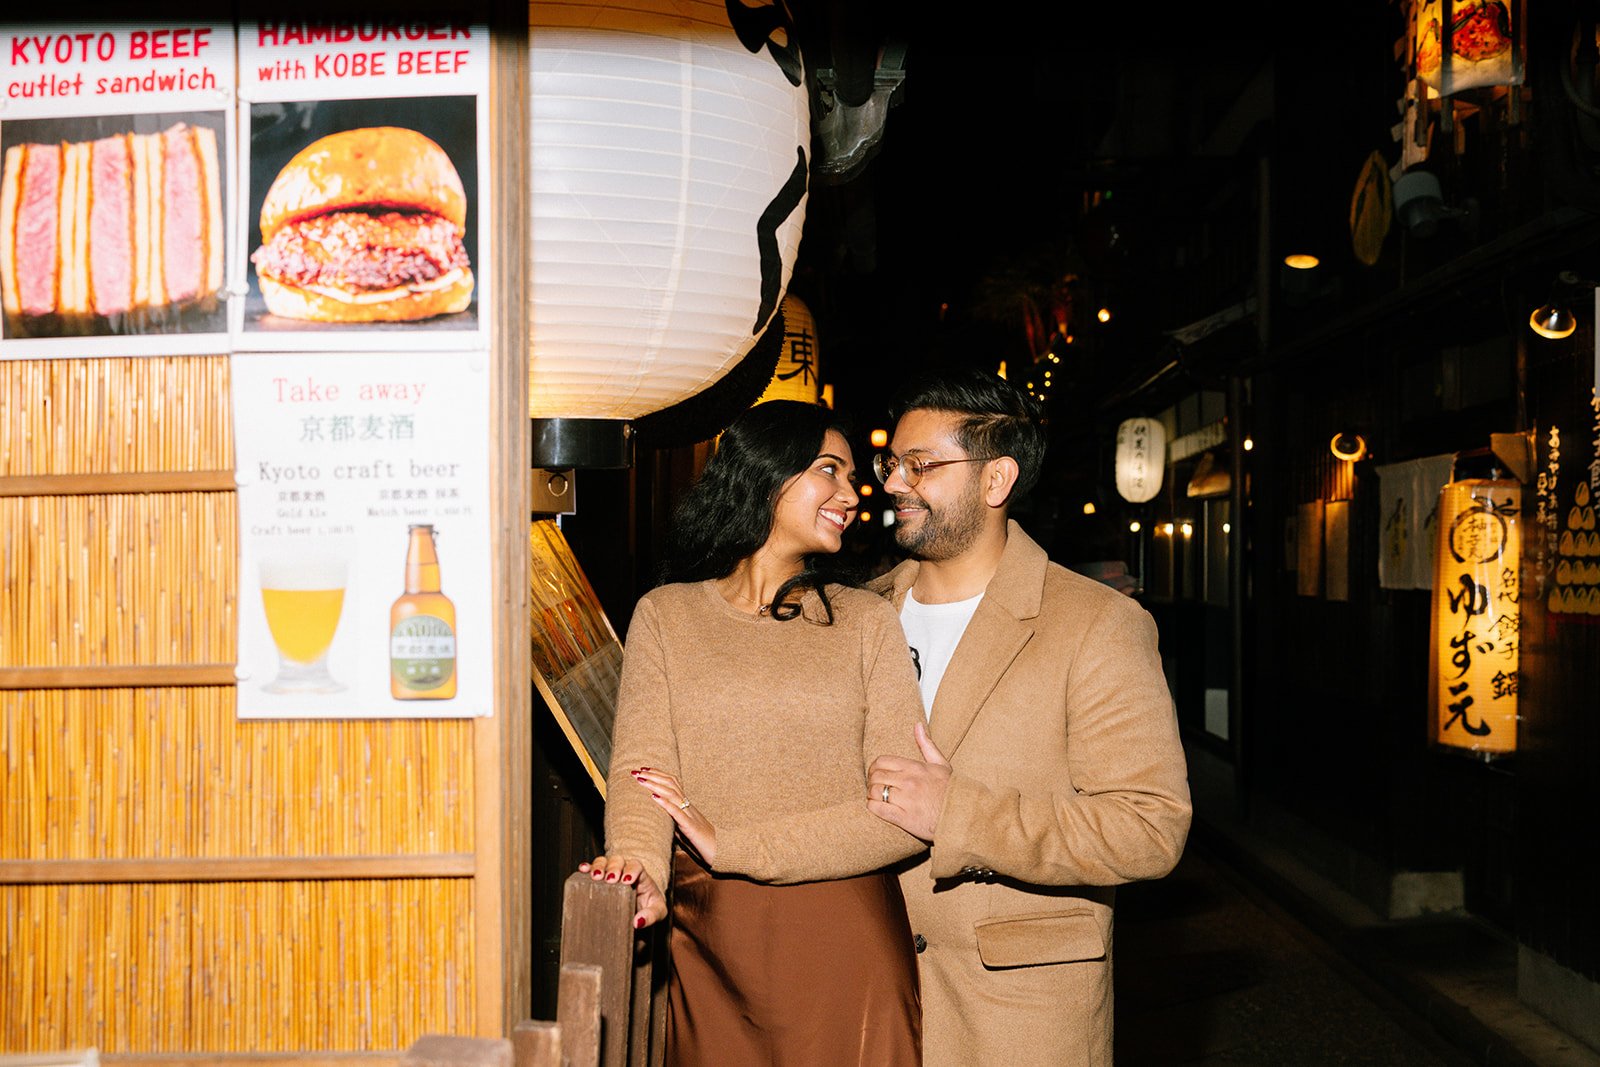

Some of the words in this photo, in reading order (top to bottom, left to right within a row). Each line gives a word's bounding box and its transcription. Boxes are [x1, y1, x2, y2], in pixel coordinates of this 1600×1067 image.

[257, 14, 473, 47] HAMBURGER
[11, 34, 115, 66] KYOTO
[129, 28, 213, 60] BEEF
[258, 60, 305, 82] with
[314, 53, 386, 79] KOBE
[397, 50, 470, 76] BEEF
[8, 73, 84, 99] cutlet
[96, 68, 216, 95] sandwich
[777, 328, 818, 386] 東
[273, 378, 340, 402] Take
[359, 382, 426, 405] away
[299, 413, 415, 443] 京都麦酒
[259, 461, 321, 484] Kyoto
[334, 460, 395, 480] craft
[409, 459, 461, 478] beer
[1443, 573, 1494, 737] ゆず元
